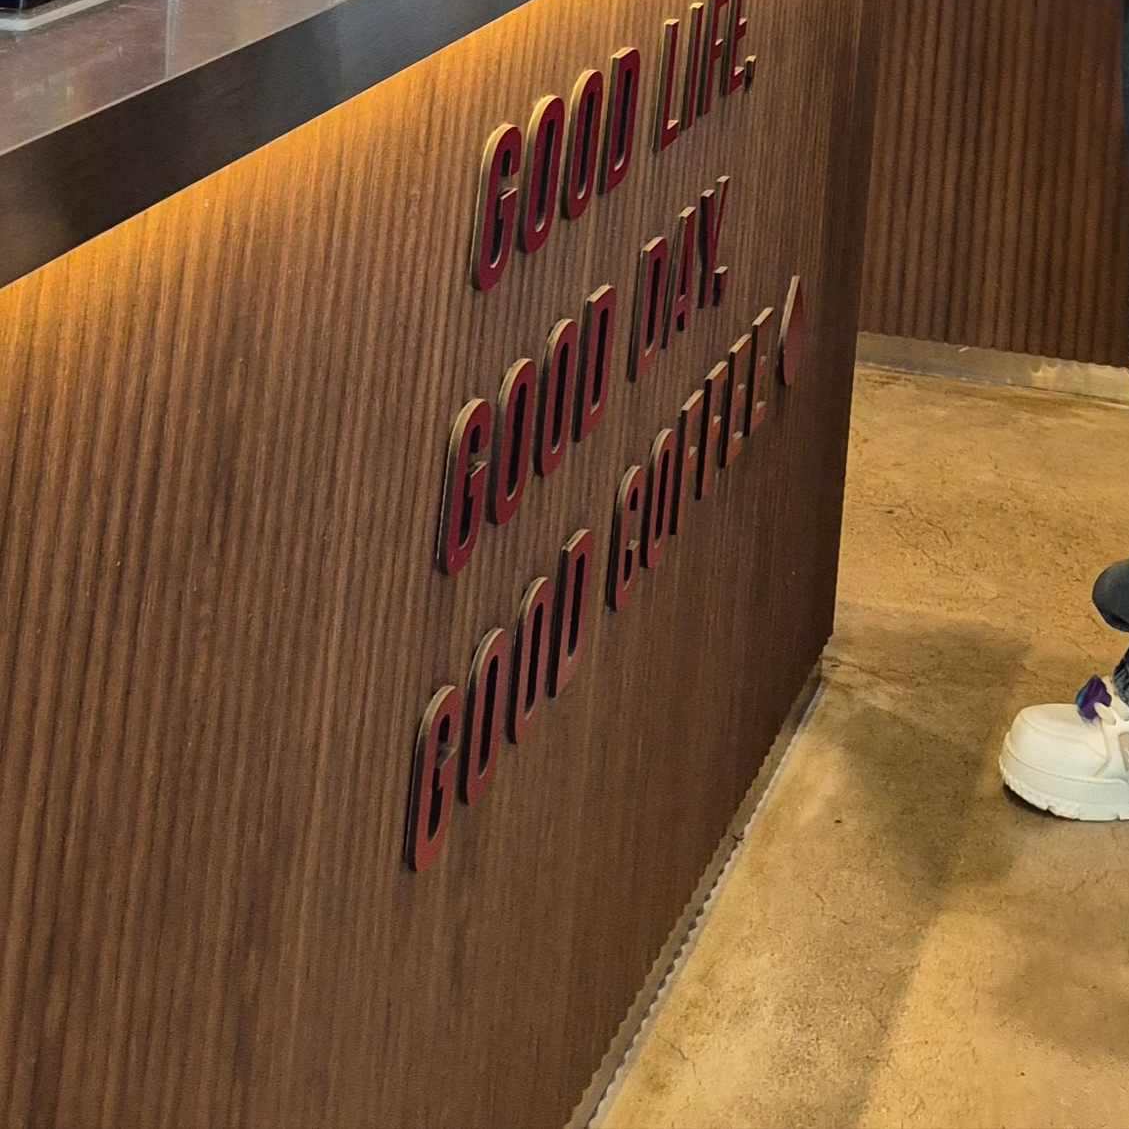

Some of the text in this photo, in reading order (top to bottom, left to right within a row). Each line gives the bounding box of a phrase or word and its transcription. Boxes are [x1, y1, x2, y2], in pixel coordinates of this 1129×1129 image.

[471, 46, 639, 290] GOOD
[436, 283, 615, 575] GOOD
[407, 306, 774, 872] GOOD COFFEE
